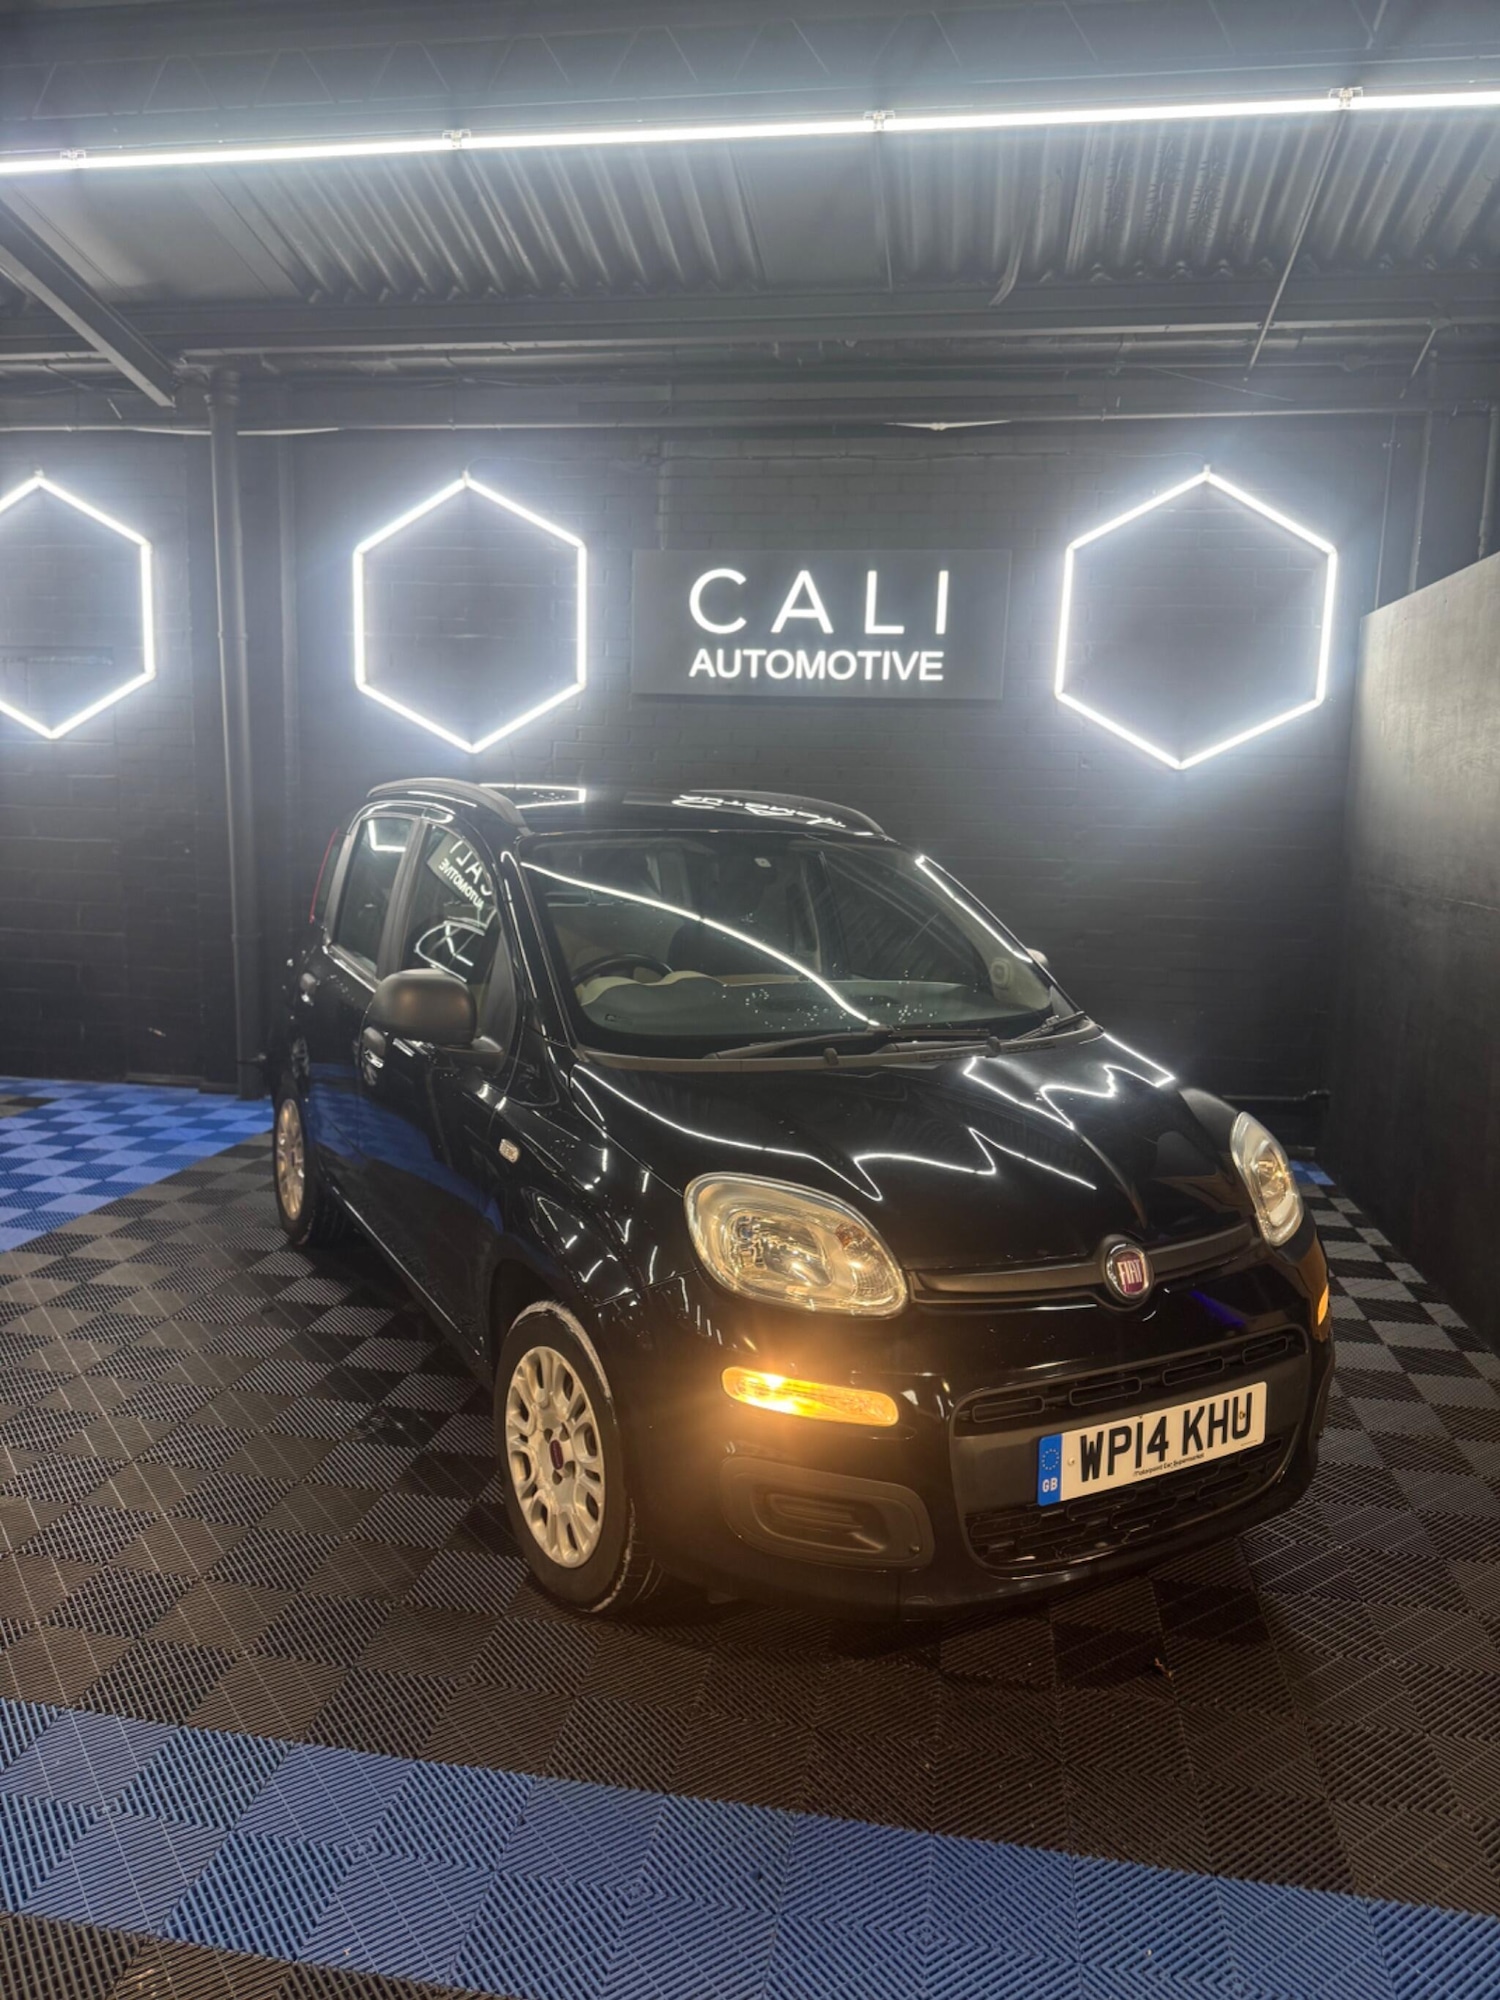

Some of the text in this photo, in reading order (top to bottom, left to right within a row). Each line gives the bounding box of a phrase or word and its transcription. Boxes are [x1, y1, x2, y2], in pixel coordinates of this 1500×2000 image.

[689, 568, 949, 634] CALI
[689, 648, 944, 681] AUTOMOTIVE
[1117, 1259, 1142, 1286] FIAT
[1080, 1392, 1252, 1482] WP14 KHU
[1042, 1477, 1058, 1493] GB
